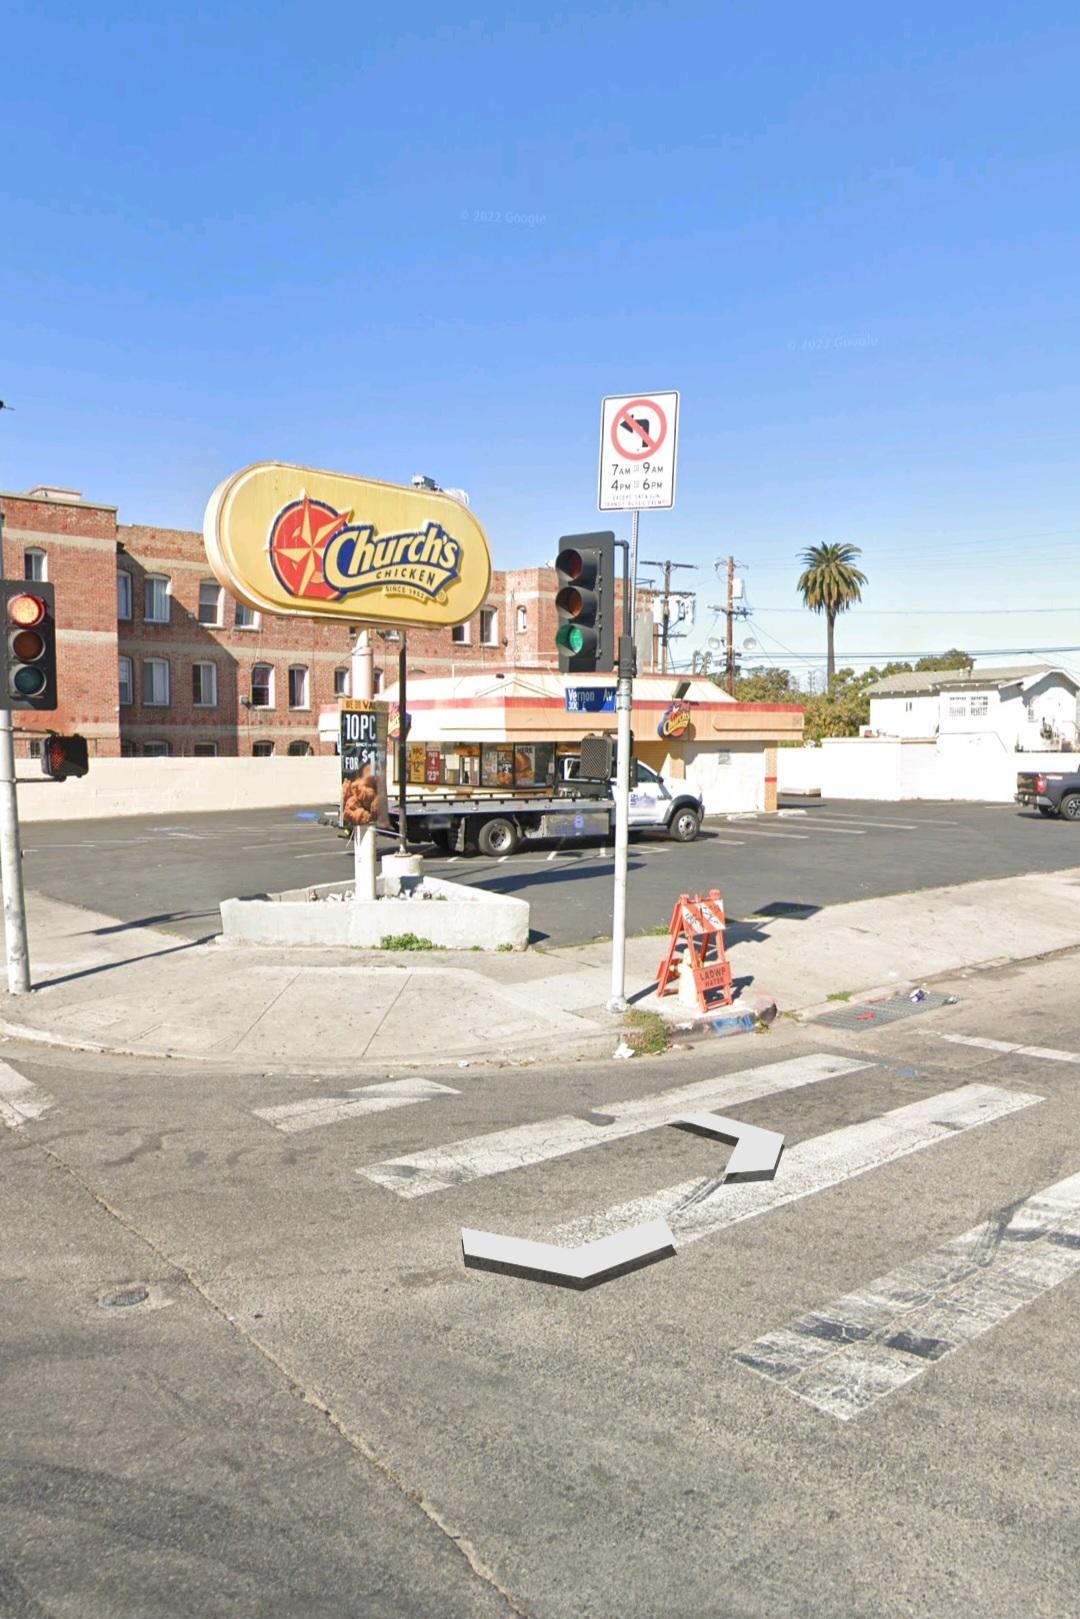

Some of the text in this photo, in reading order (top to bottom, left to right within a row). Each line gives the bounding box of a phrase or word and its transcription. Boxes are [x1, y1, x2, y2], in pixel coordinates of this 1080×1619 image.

[325, 527, 458, 586] Church's
[376, 568, 436, 586] CHICKEN
[386, 586, 425, 599] SINCE 1952
[568, 689, 595, 702] Vernon
[346, 714, 376, 740] 10PC
[345, 757, 359, 770] FOR
[700, 967, 726, 981] LADWP
